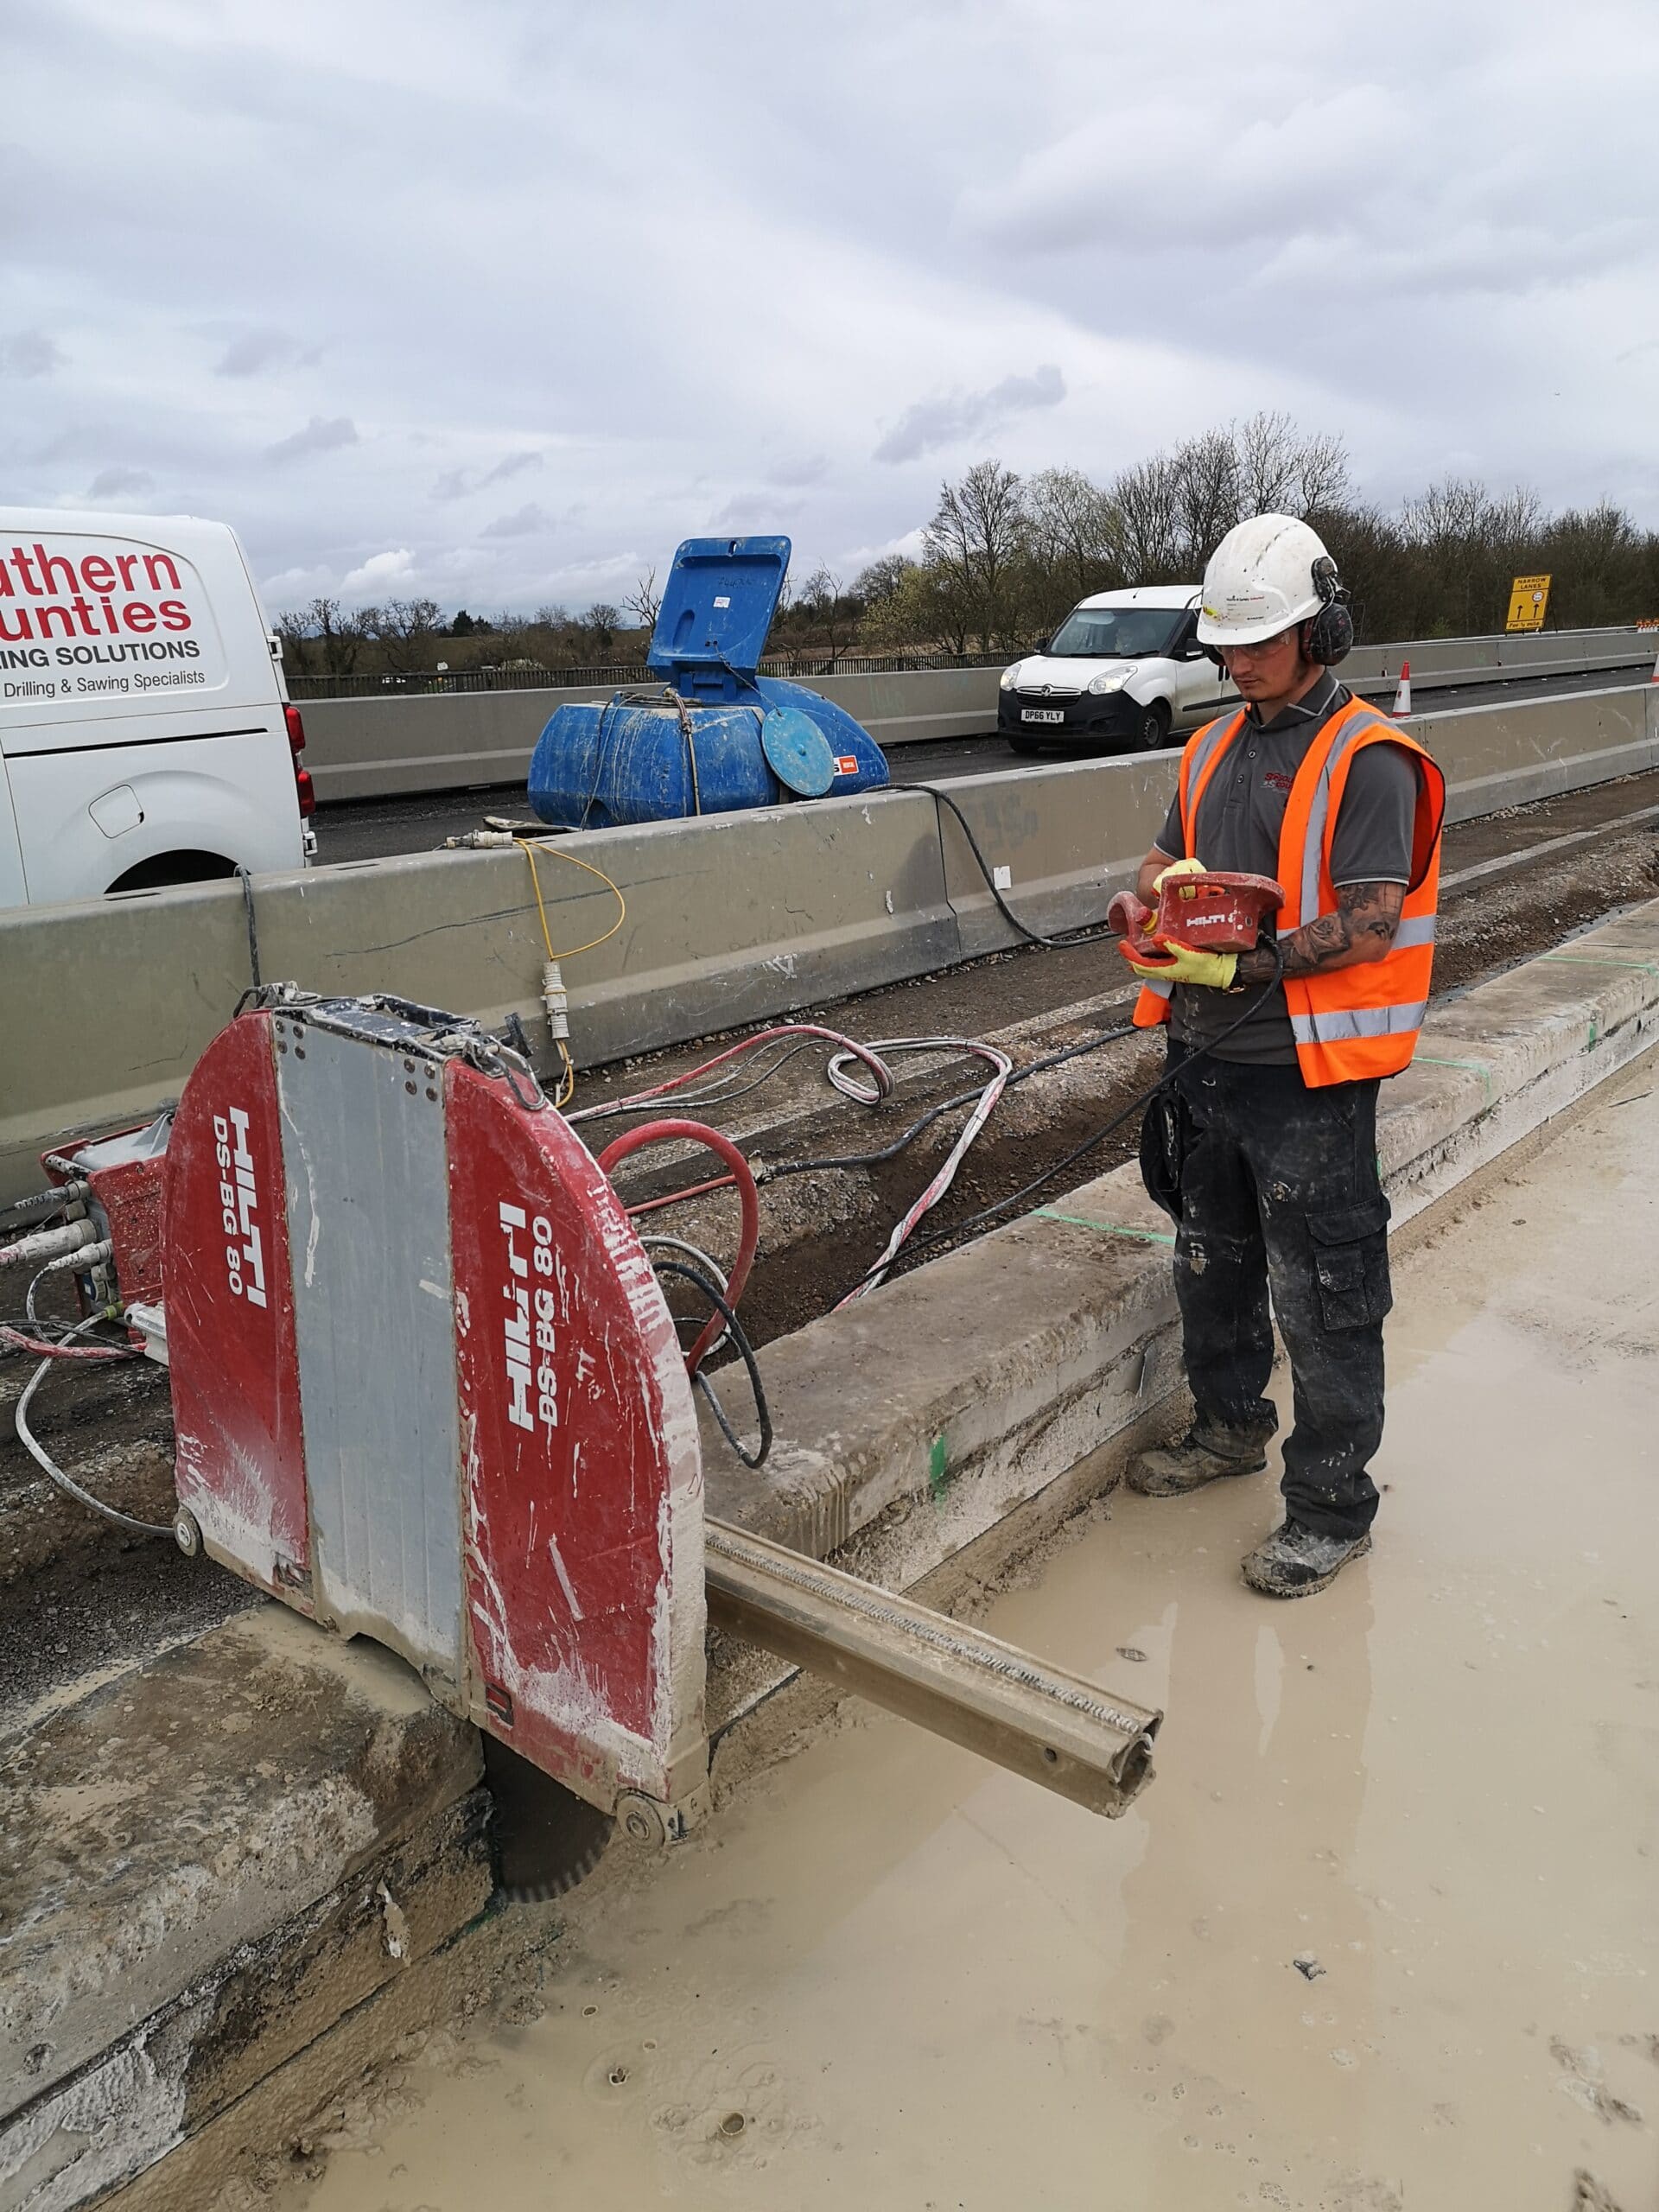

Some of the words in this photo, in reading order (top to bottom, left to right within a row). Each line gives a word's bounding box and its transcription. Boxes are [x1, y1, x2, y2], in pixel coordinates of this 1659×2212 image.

[0, 648, 50, 670] ING
[55, 640, 200, 665] SOLUTIONS
[4, 681, 55, 698] Drilling
[60, 678, 72, 693] &
[77, 676, 129, 692] Sawing
[134, 671, 205, 690] Specialists
[1025, 710, 1045, 720] DP66
[1046, 711, 1061, 721] YLY
[1186, 914, 1225, 927] HILTI
[213, 1115, 238, 1236] DS-BG
[226, 1245, 243, 1295] 80
[229, 1106, 267, 1308] HILTI
[532, 1216, 554, 1277] 80
[499, 1201, 534, 1433] HILTI
[534, 1287, 558, 1427] DS-BG
